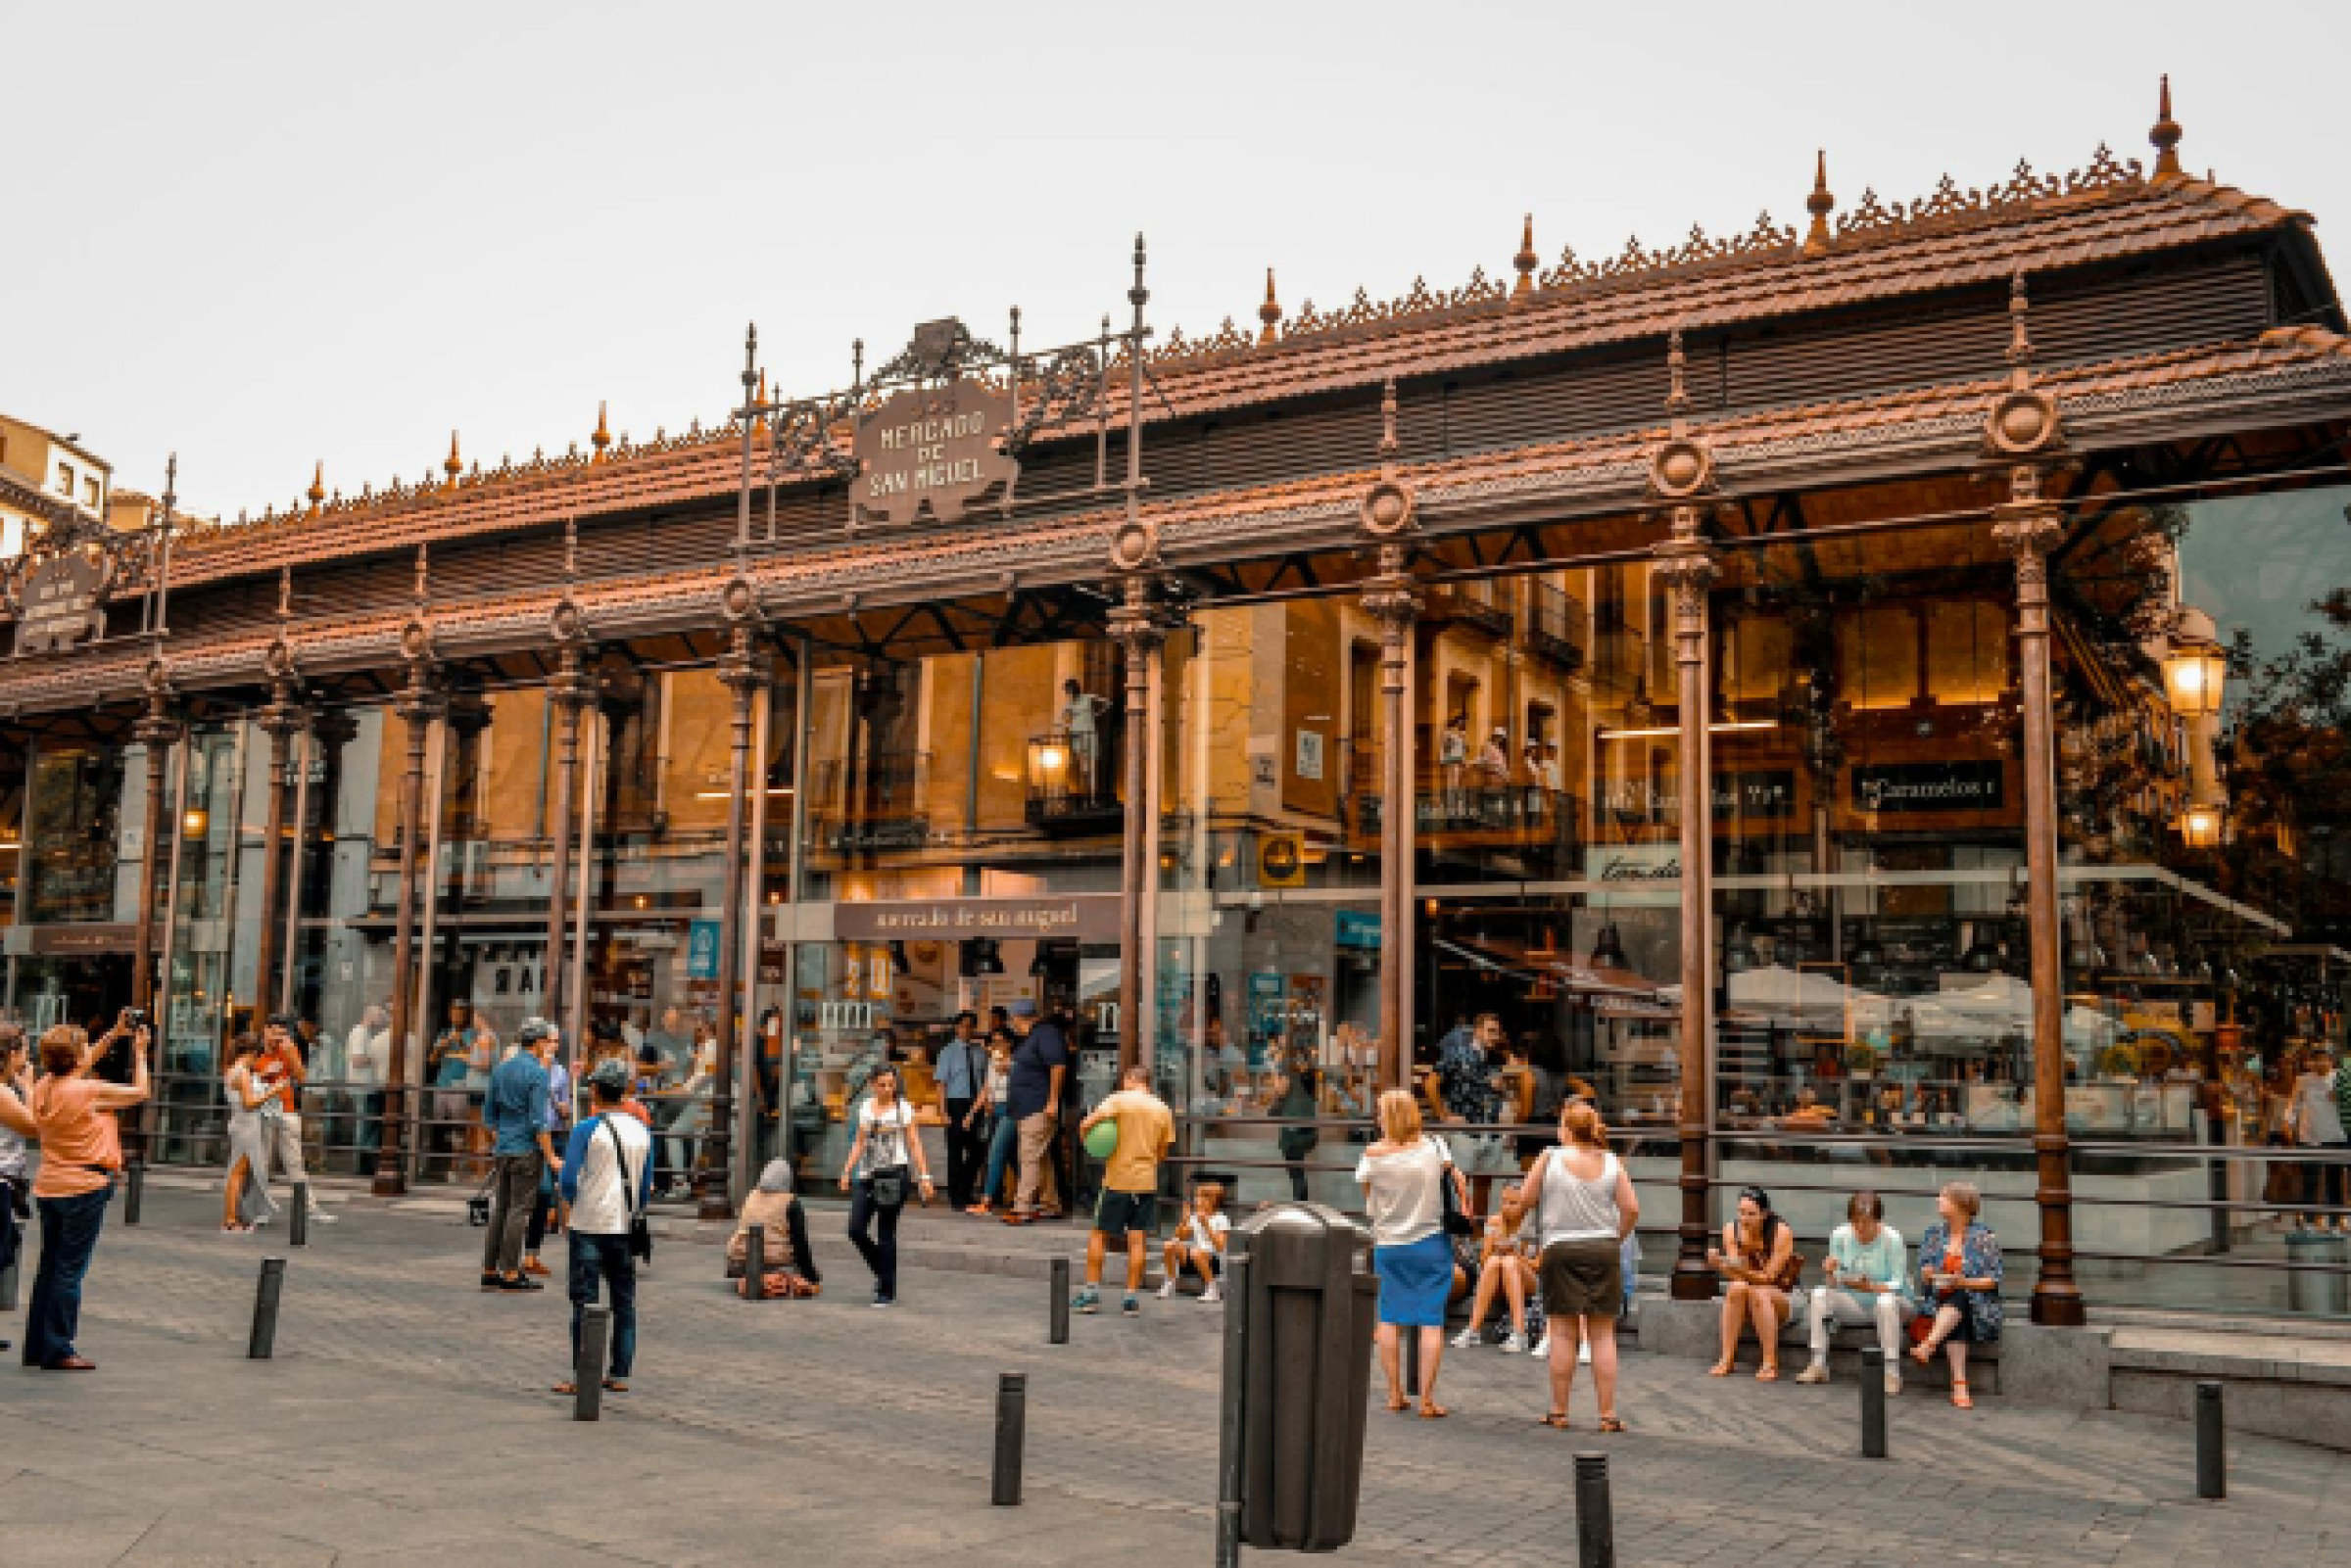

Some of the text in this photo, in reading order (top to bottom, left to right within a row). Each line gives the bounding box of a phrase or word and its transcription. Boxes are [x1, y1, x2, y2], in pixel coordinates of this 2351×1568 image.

[881, 410, 985, 450] MERCADO
[917, 444, 945, 464] DE
[869, 458, 985, 497] SAN MIGUEL
[876, 902, 1078, 933] mercado de san miguel
